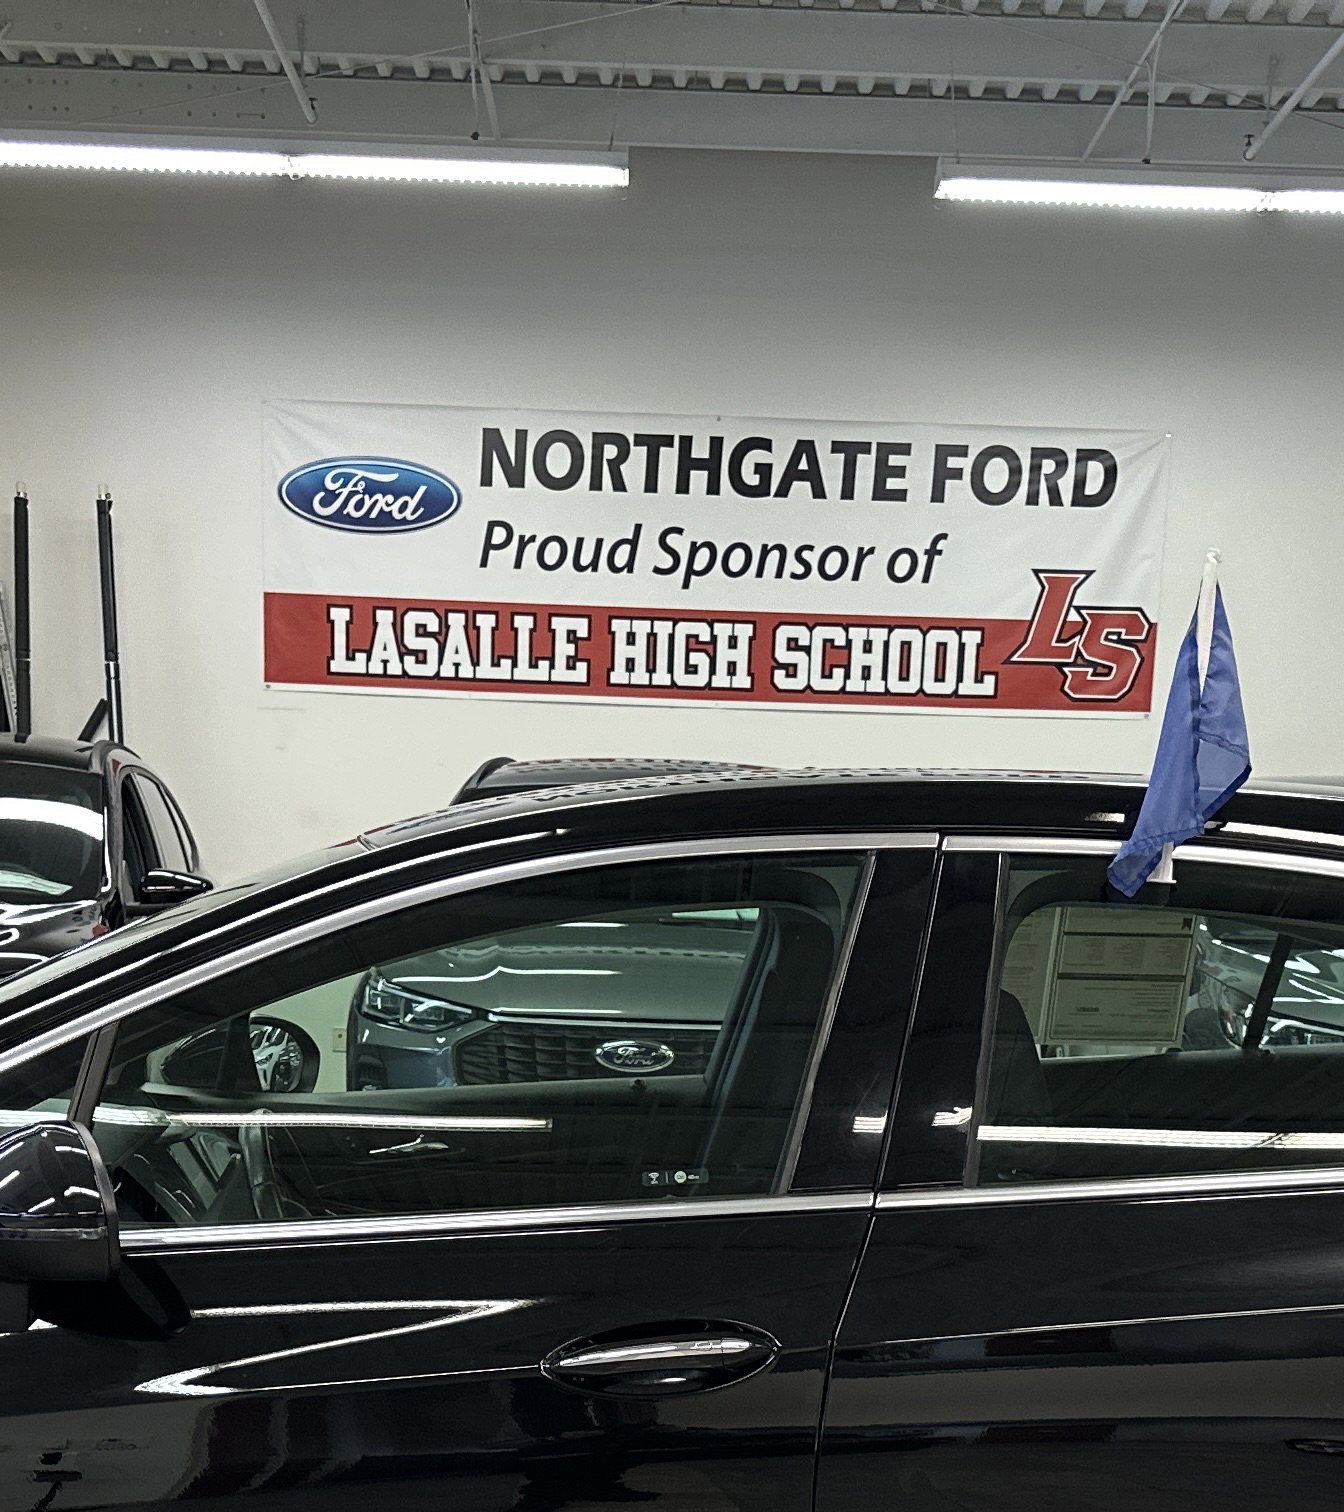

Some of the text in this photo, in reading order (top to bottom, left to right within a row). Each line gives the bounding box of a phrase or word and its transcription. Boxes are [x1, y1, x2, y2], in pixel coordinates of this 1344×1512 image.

[313, 467, 428, 521] Ford
[480, 427, 1118, 508] NORTHGATE FORD
[479, 520, 949, 590] Proud Sponsor of
[328, 606, 997, 697] LASALLE HIGH SCHOOL
[1002, 568, 1152, 702] LS
[613, 1046, 656, 1065] Ford
